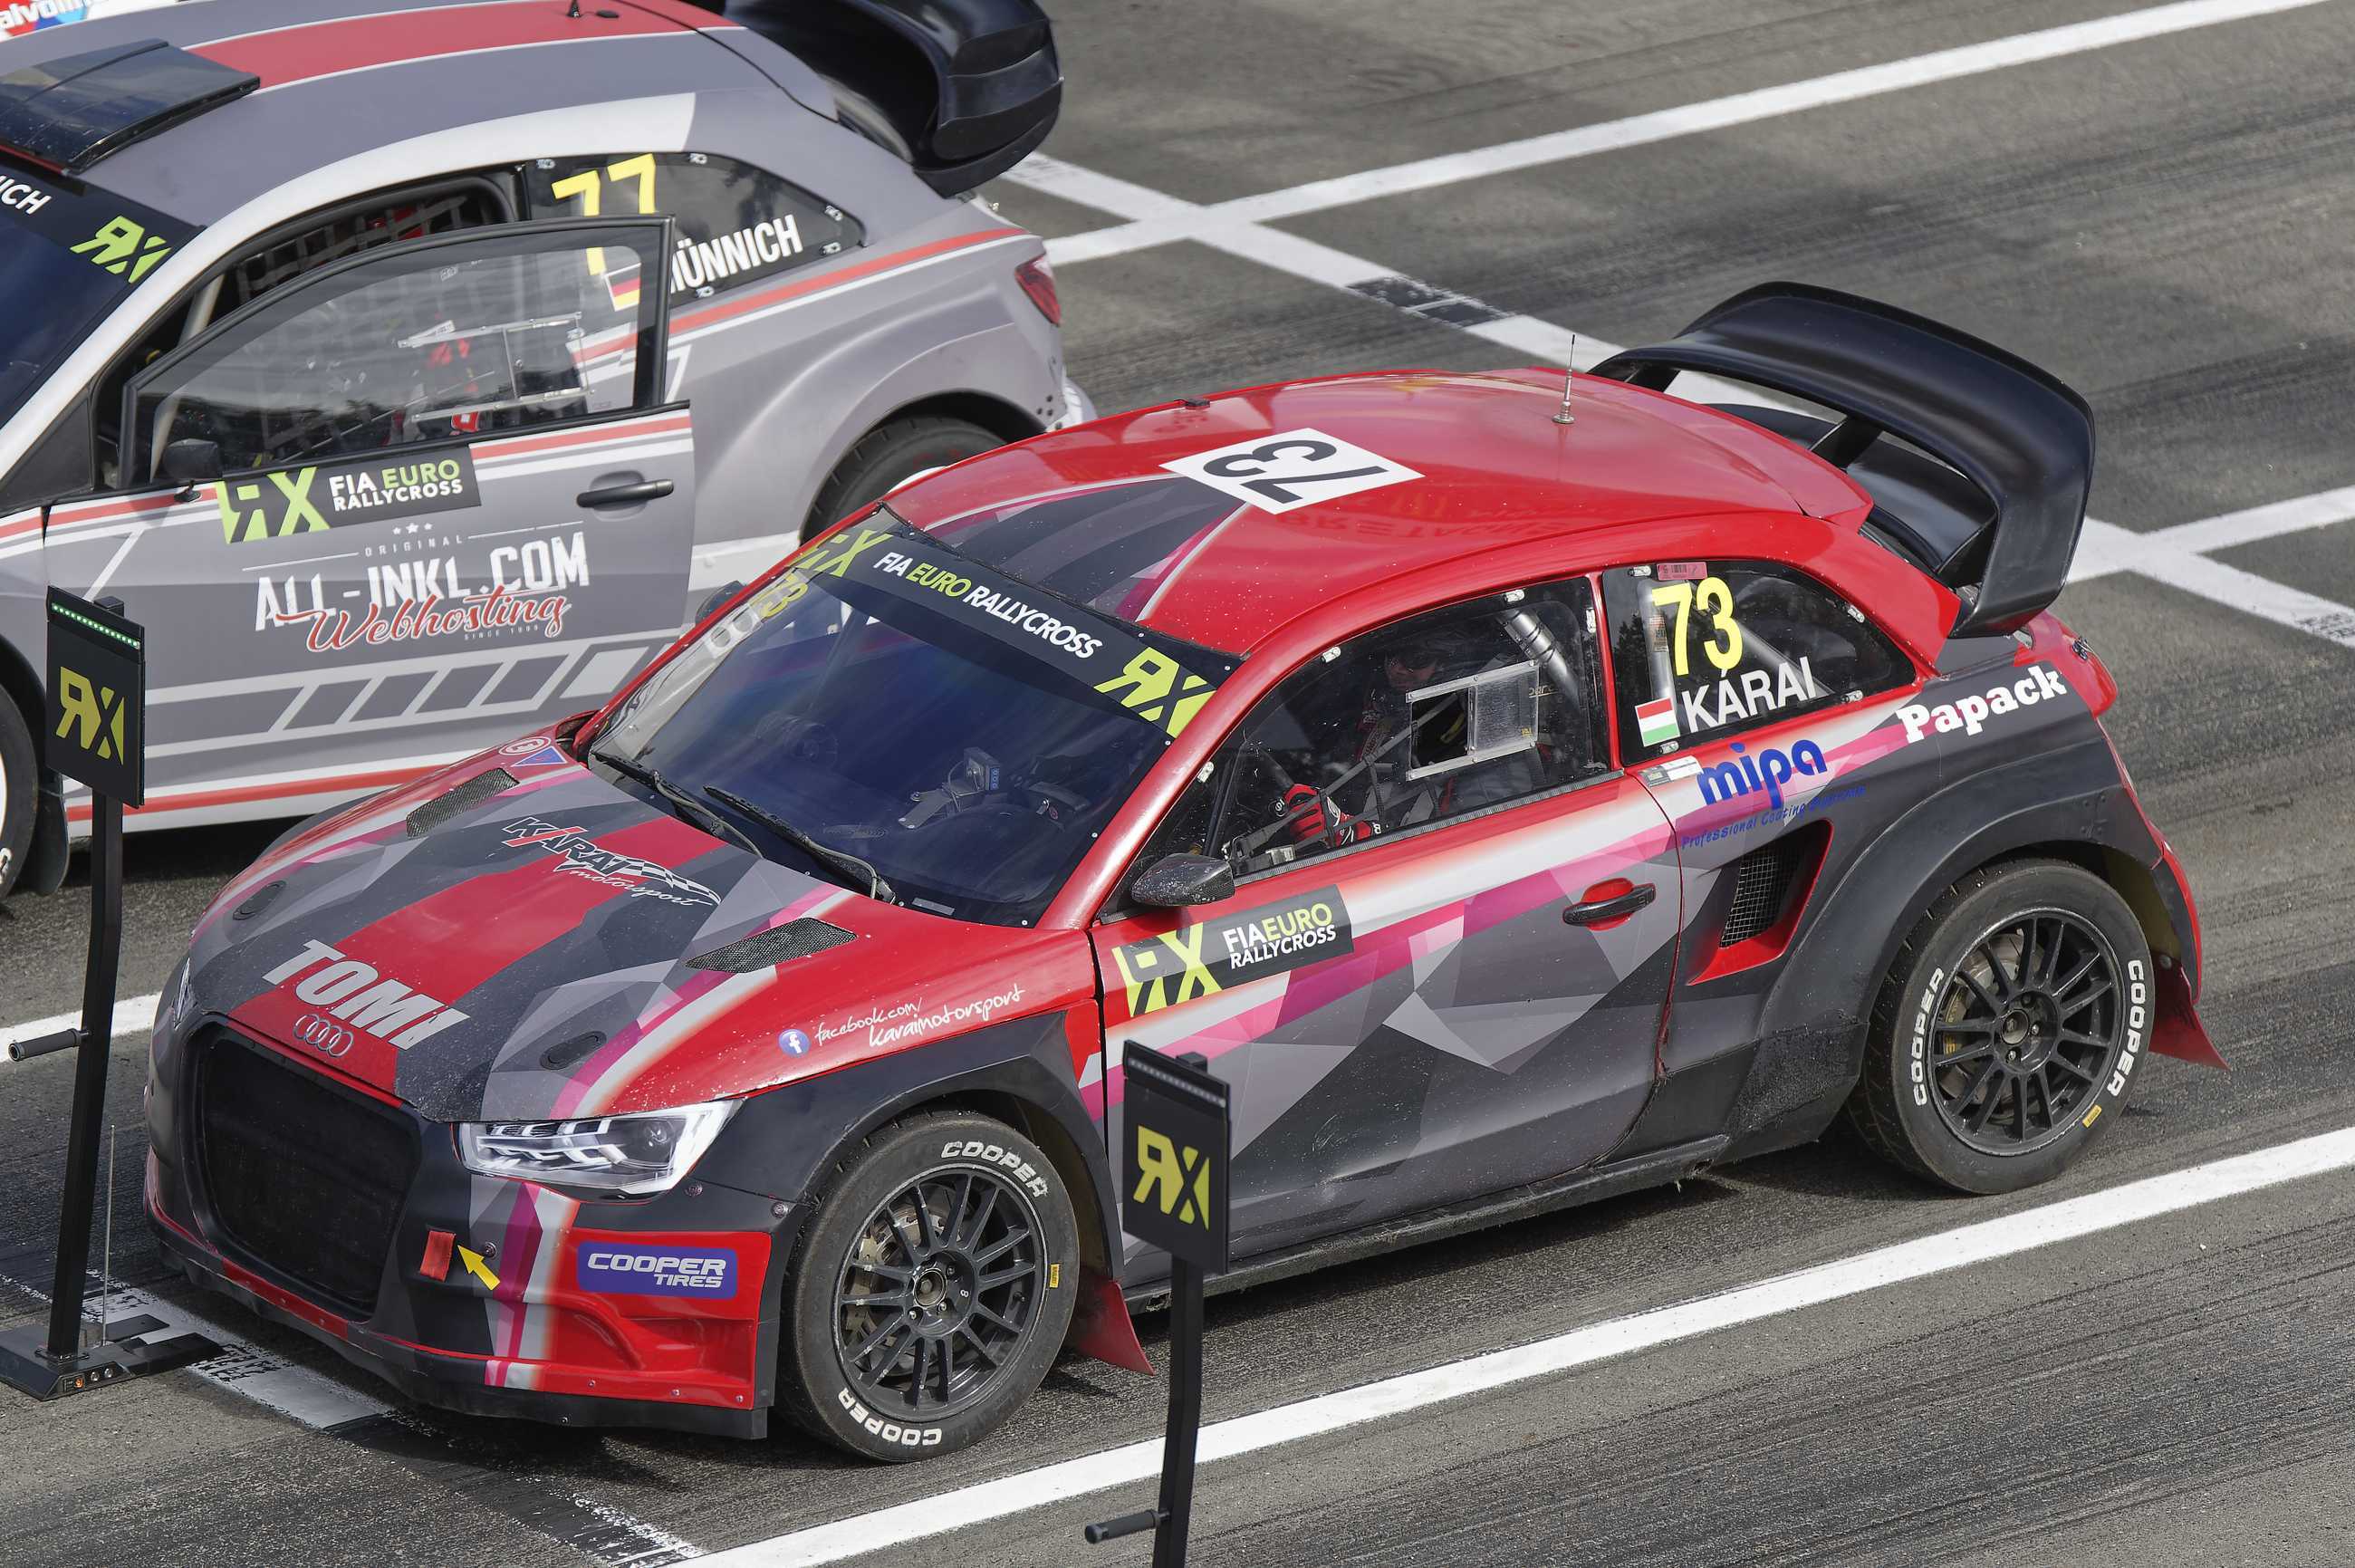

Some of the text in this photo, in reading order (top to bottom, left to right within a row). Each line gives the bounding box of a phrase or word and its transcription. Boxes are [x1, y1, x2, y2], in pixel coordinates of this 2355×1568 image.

[329, 459, 460, 497] FIA EURO
[332, 479, 463, 512] RALLYCROSS
[1203, 439, 1389, 505] 73
[365, 534, 464, 558] ORIGINAL
[275, 584, 572, 653] Webhosting
[873, 552, 1103, 659] FIA EURO RALLYCROSS
[1652, 576, 1744, 676] 73
[1681, 656, 1817, 733] KÁRAI
[1895, 665, 2068, 744] Papack
[1697, 739, 1828, 810] mipa
[1681, 818, 1758, 851] Professional
[569, 870, 714, 906] motorsport
[1223, 903, 1333, 953] FIA EURO
[1230, 924, 1337, 969] RALLYCROSS
[262, 938, 471, 1051] TOMI
[1910, 967, 1945, 1106] COOPER
[2106, 960, 2146, 1097] COOPER
[940, 1140, 1052, 1198] COOPER
[588, 1253, 726, 1276] COOPER
[653, 1274, 724, 1288] TIRES
[838, 1388, 942, 1447] COOPER
